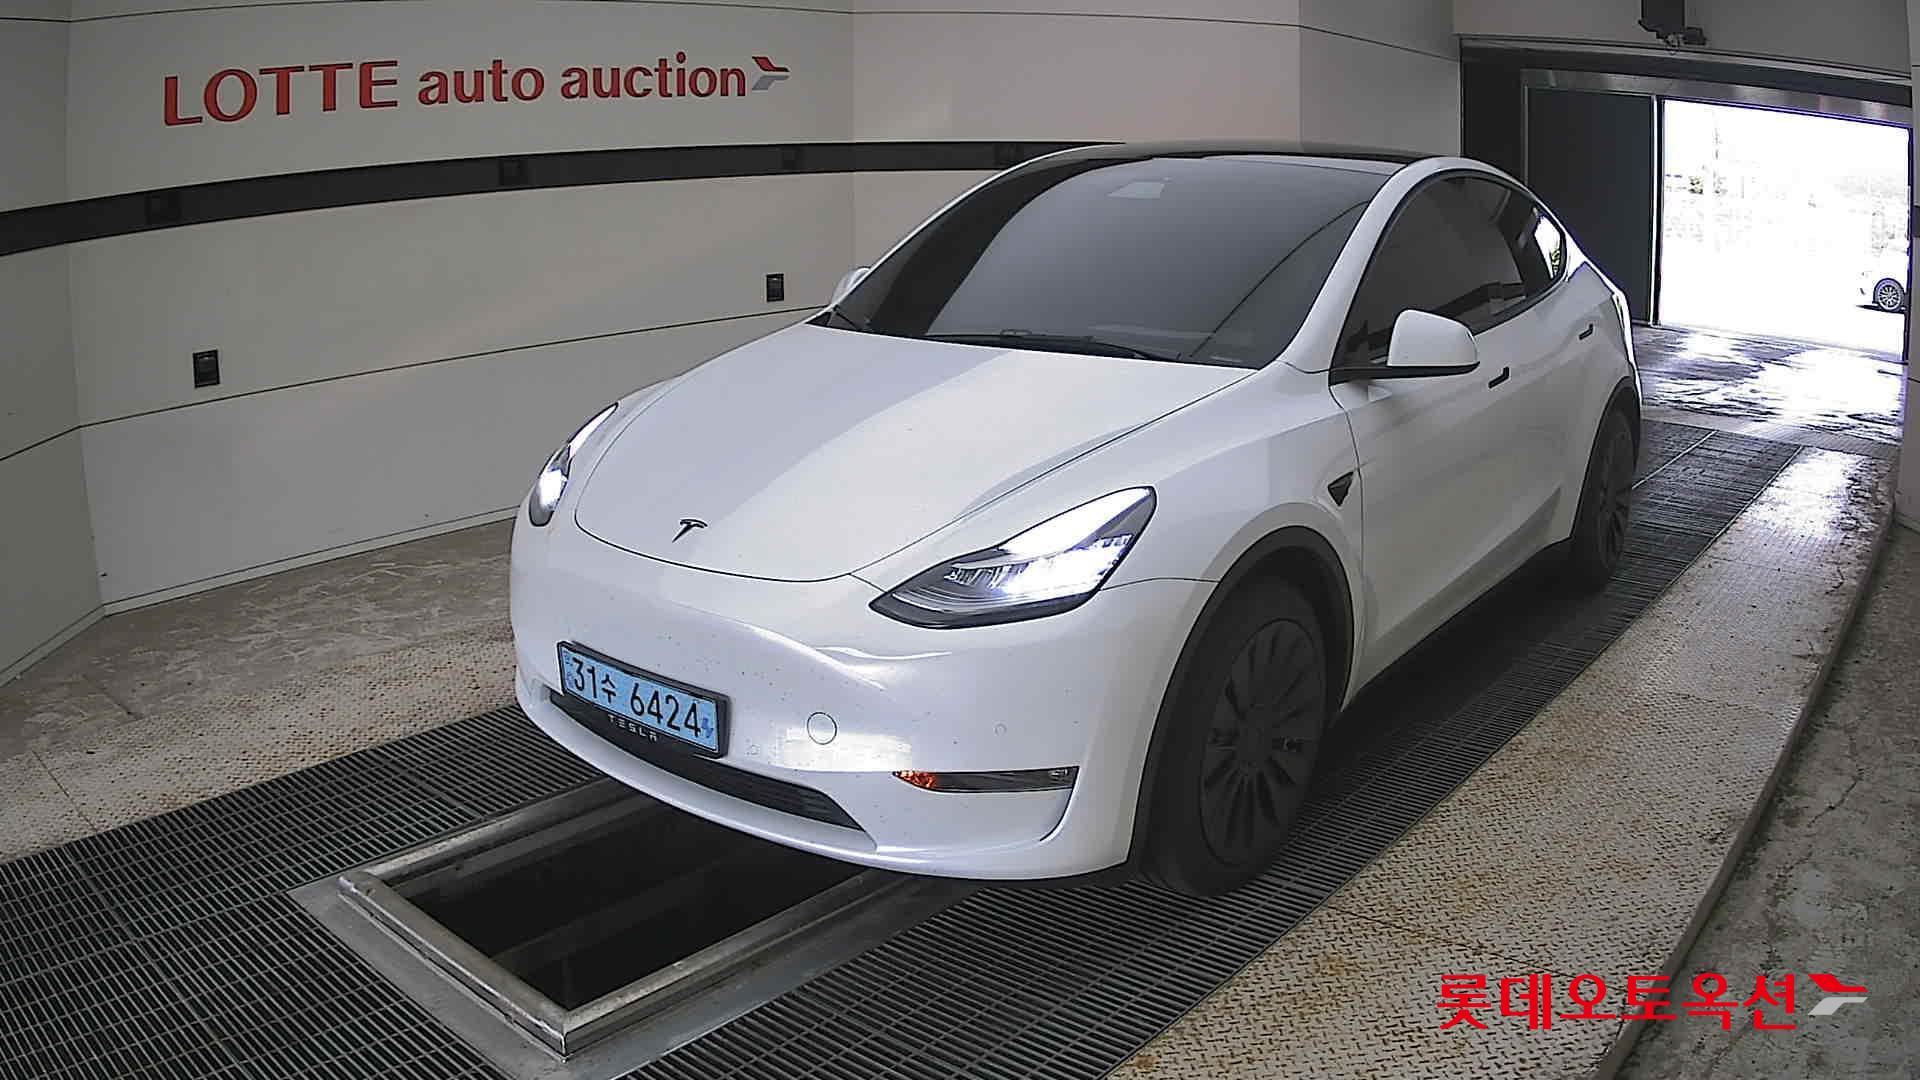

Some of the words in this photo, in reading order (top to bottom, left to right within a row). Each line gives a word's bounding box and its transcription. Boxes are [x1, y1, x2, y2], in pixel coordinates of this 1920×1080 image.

[163, 60, 398, 126] LOTTE
[417, 59, 545, 105] auto
[560, 51, 747, 99] auction
[572, 656, 617, 704] 31수
[630, 682, 701, 738] 6424
